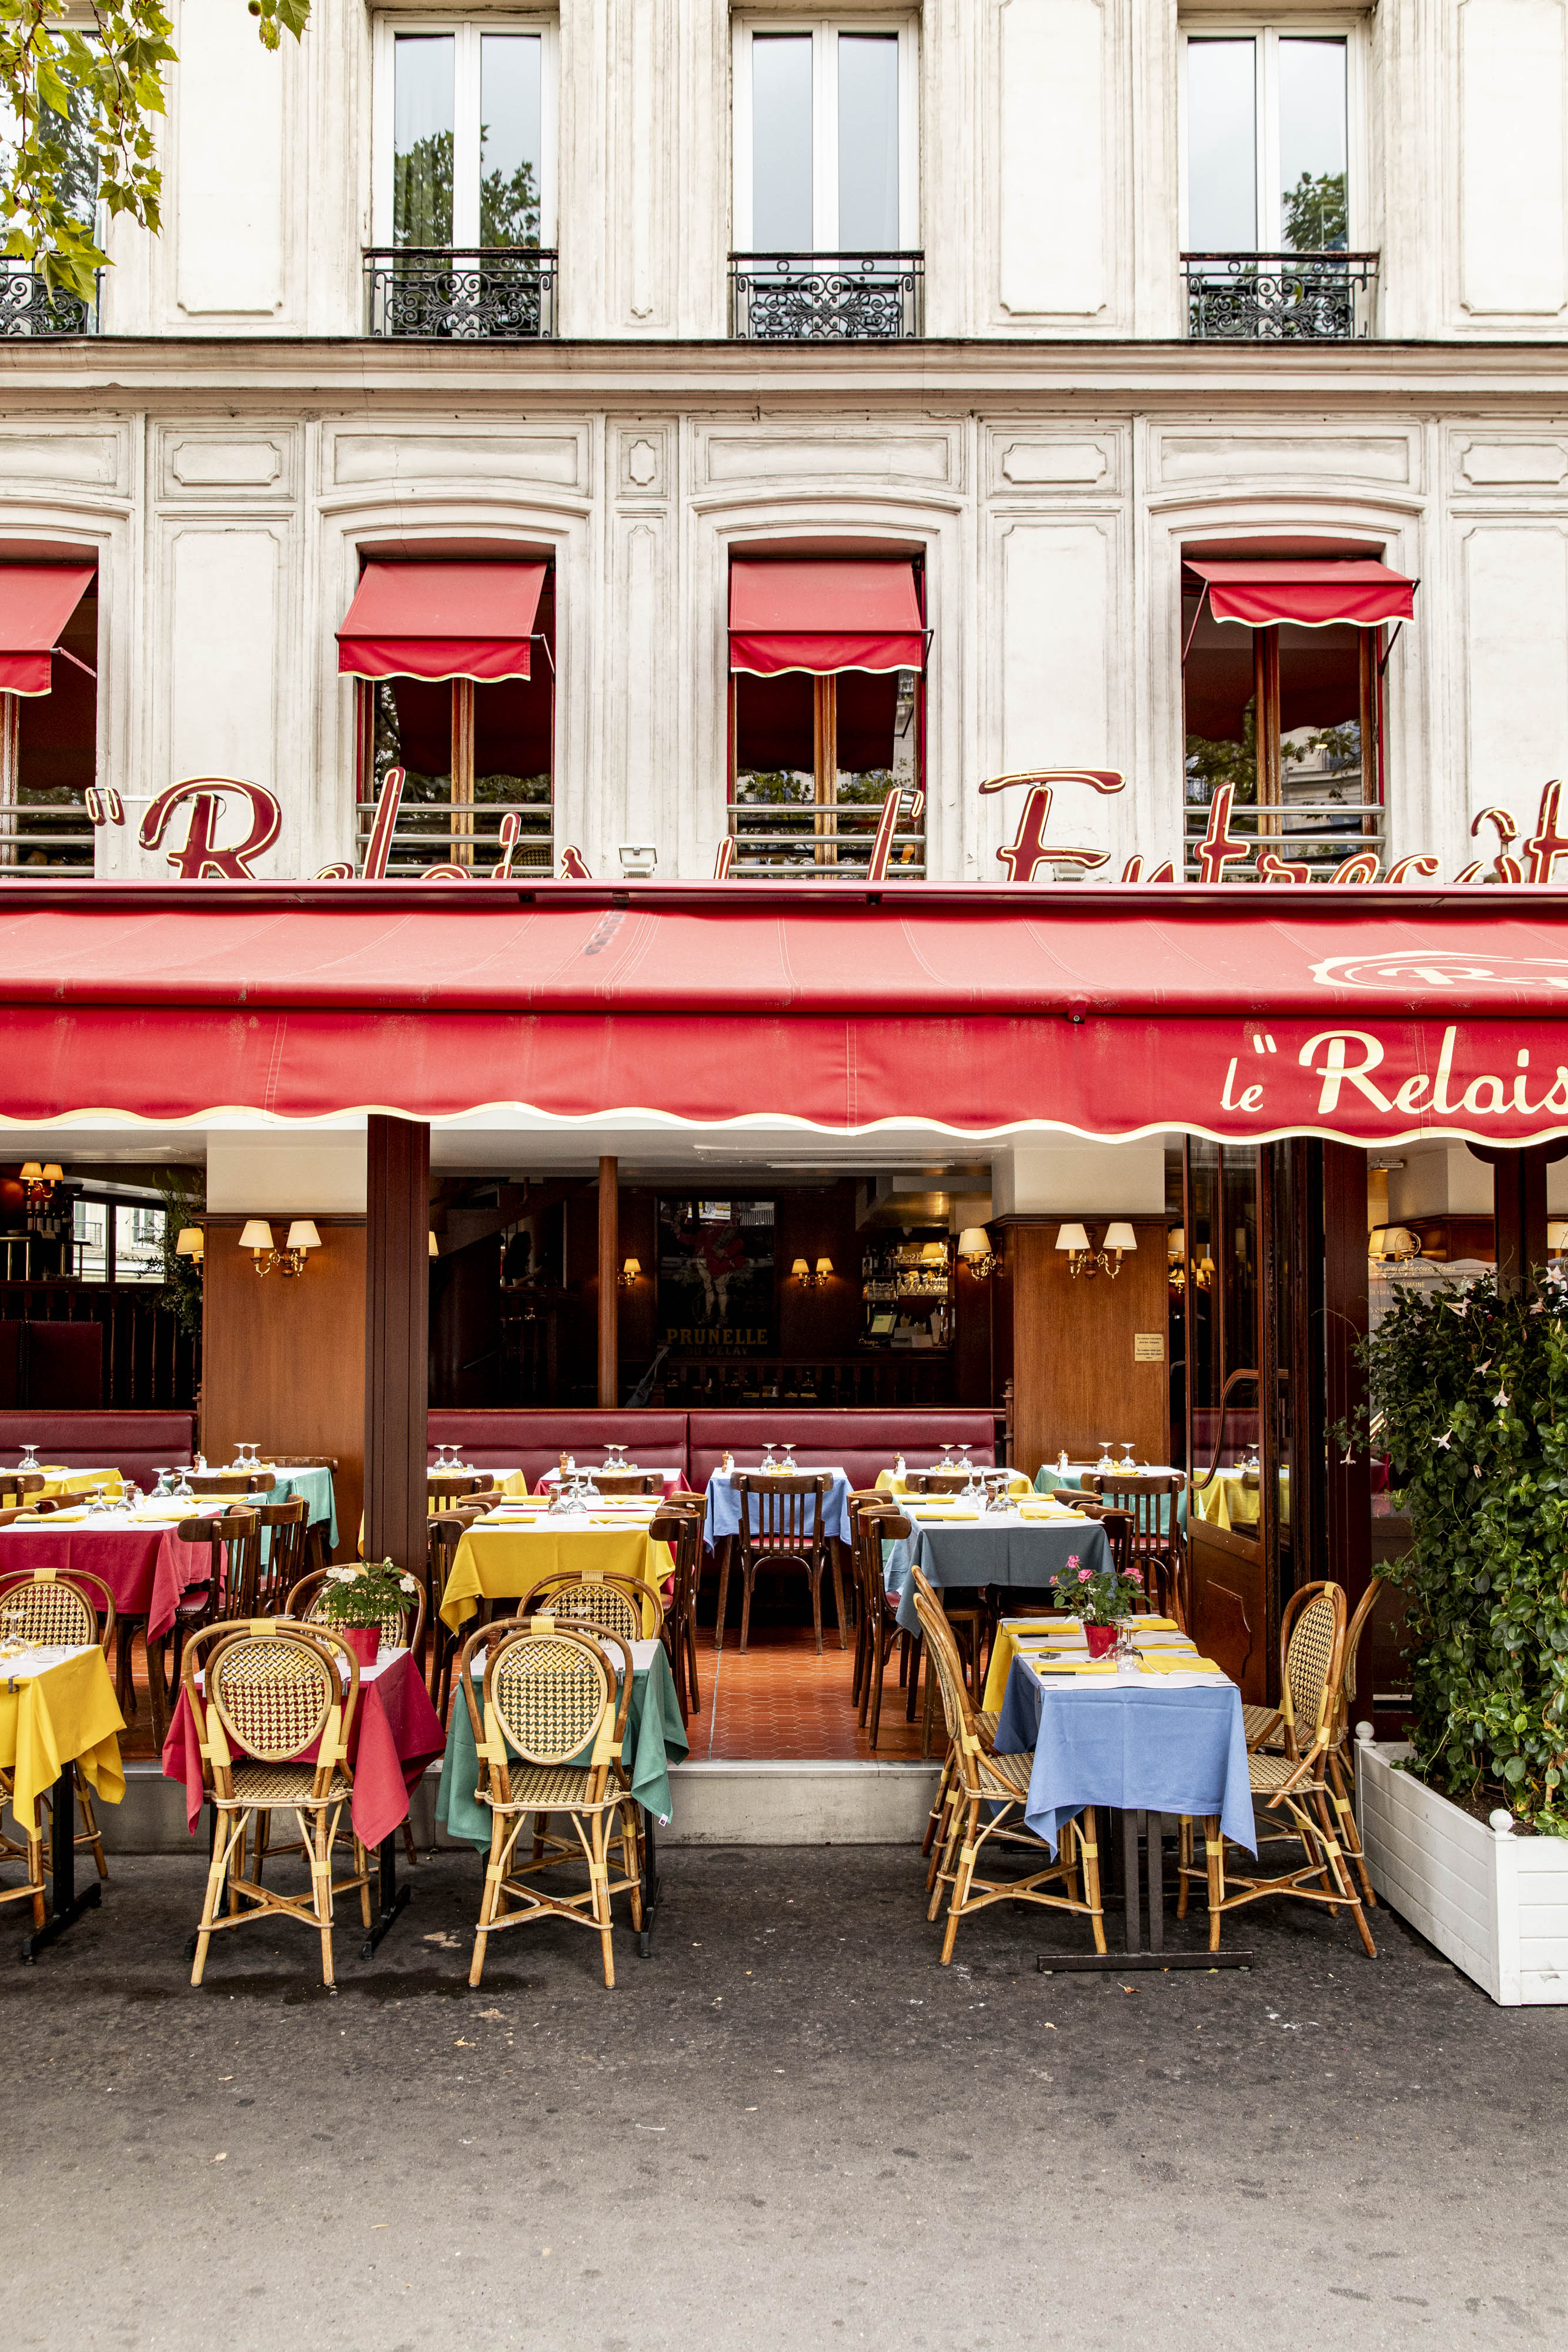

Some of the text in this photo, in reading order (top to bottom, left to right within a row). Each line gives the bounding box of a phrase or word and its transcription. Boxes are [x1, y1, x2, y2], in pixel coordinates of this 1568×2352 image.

[1220, 1057, 1263, 1112] le
[666, 1328, 768, 1345] PRUNELLE
[707, 1346, 748, 1355] VELAY
